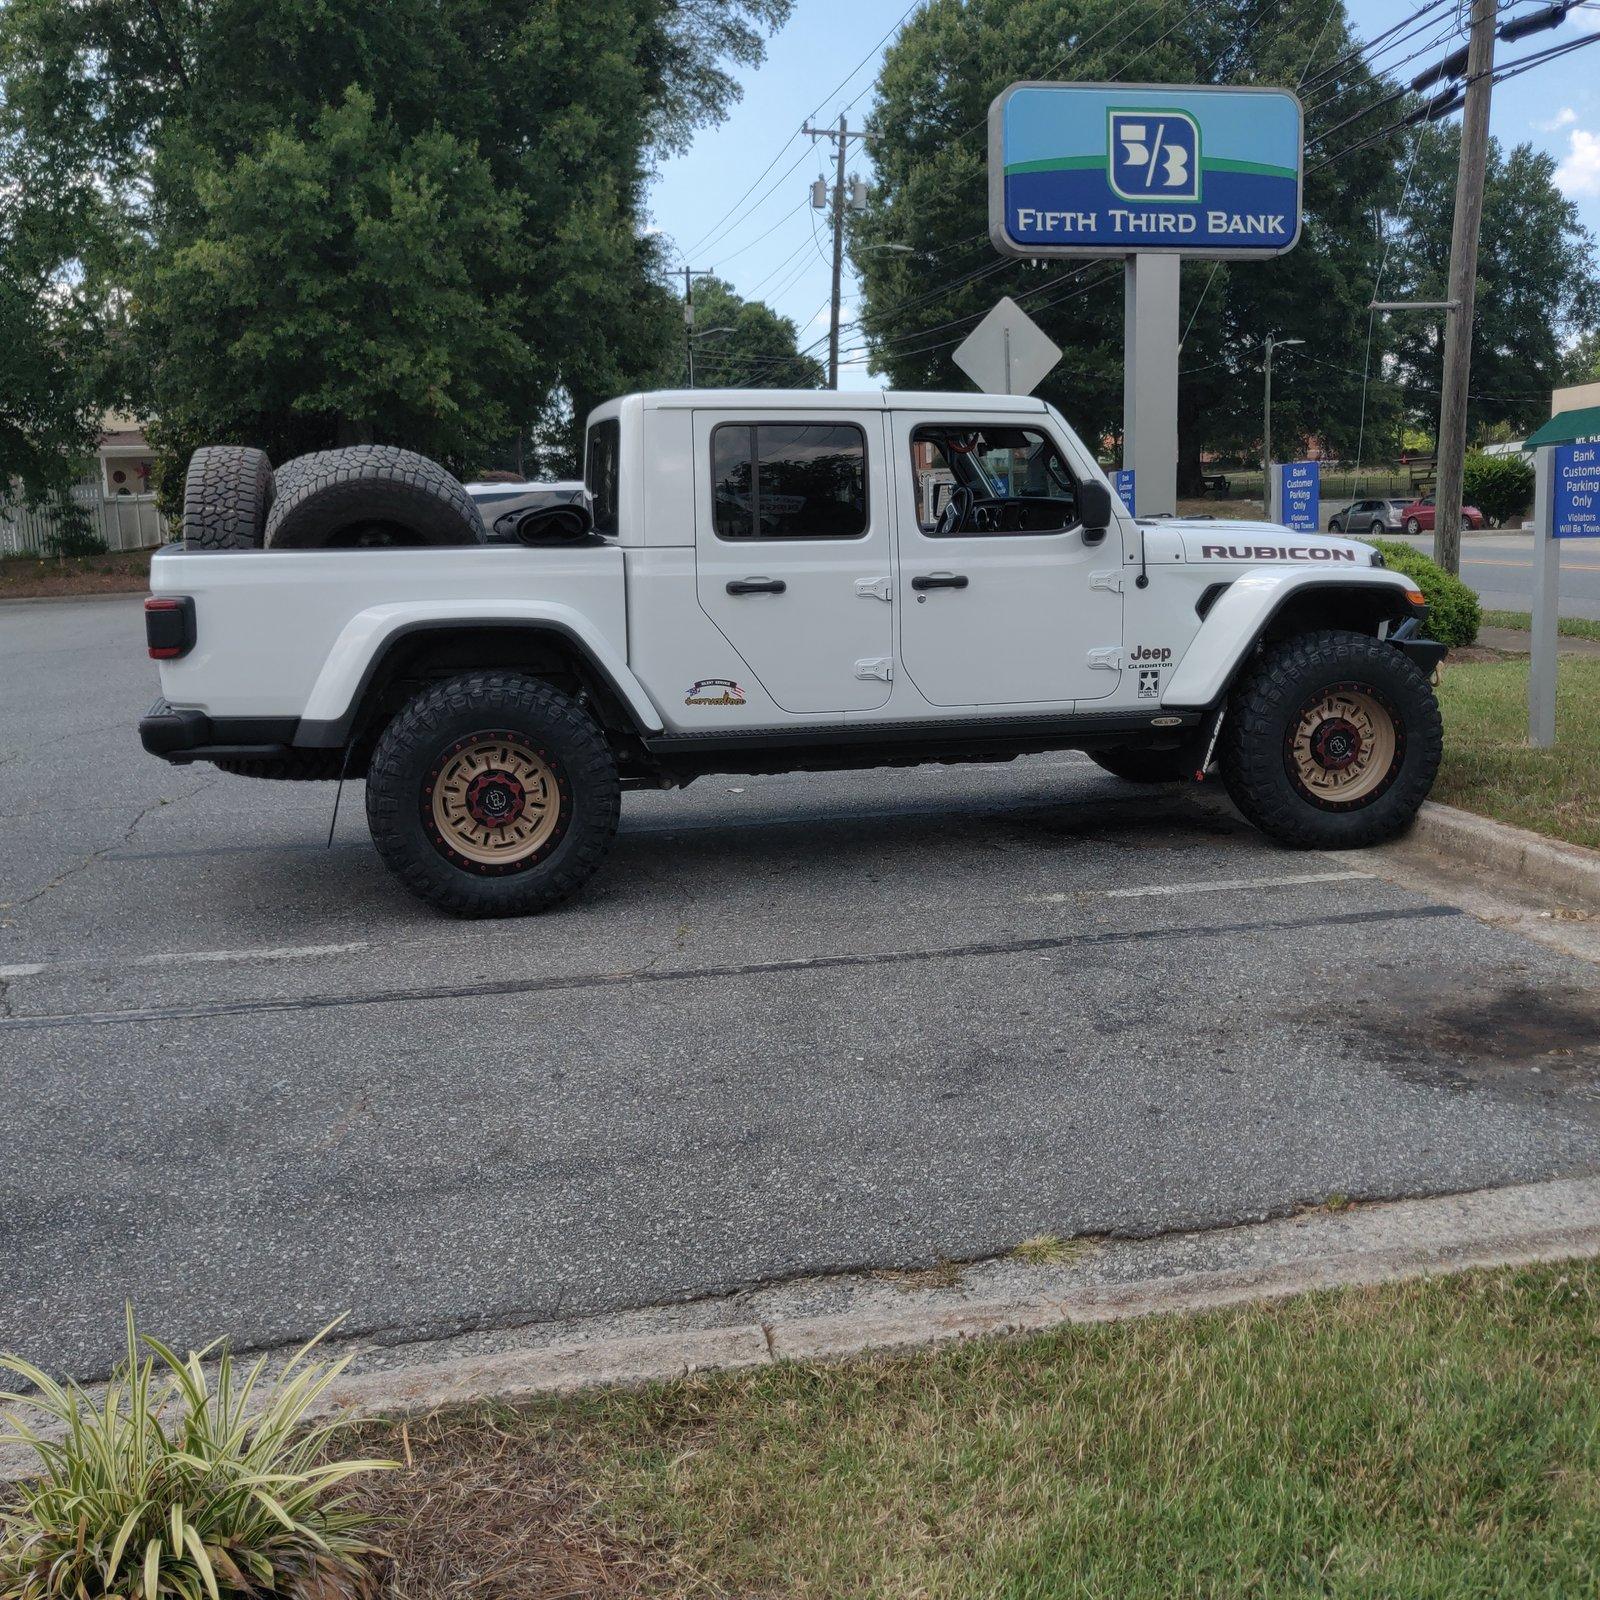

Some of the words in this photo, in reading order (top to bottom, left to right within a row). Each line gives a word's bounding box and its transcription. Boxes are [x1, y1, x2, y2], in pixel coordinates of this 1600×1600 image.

[1573, 450, 1595, 462] Bank
[1293, 468, 1307, 477] Bank
[1286, 480, 1313, 489] Customer
[1567, 481, 1599, 493] Parking
[1289, 490, 1311, 500] Parking
[1294, 502, 1306, 511] Only
[1572, 495, 1592, 508] Only
[1568, 514, 1596, 522] Violators
[1560, 525, 1571, 533] Will
[1573, 525, 1581, 533] Be
[1202, 545, 1355, 561] RUBICON
[1130, 645, 1172, 662] Jeep
